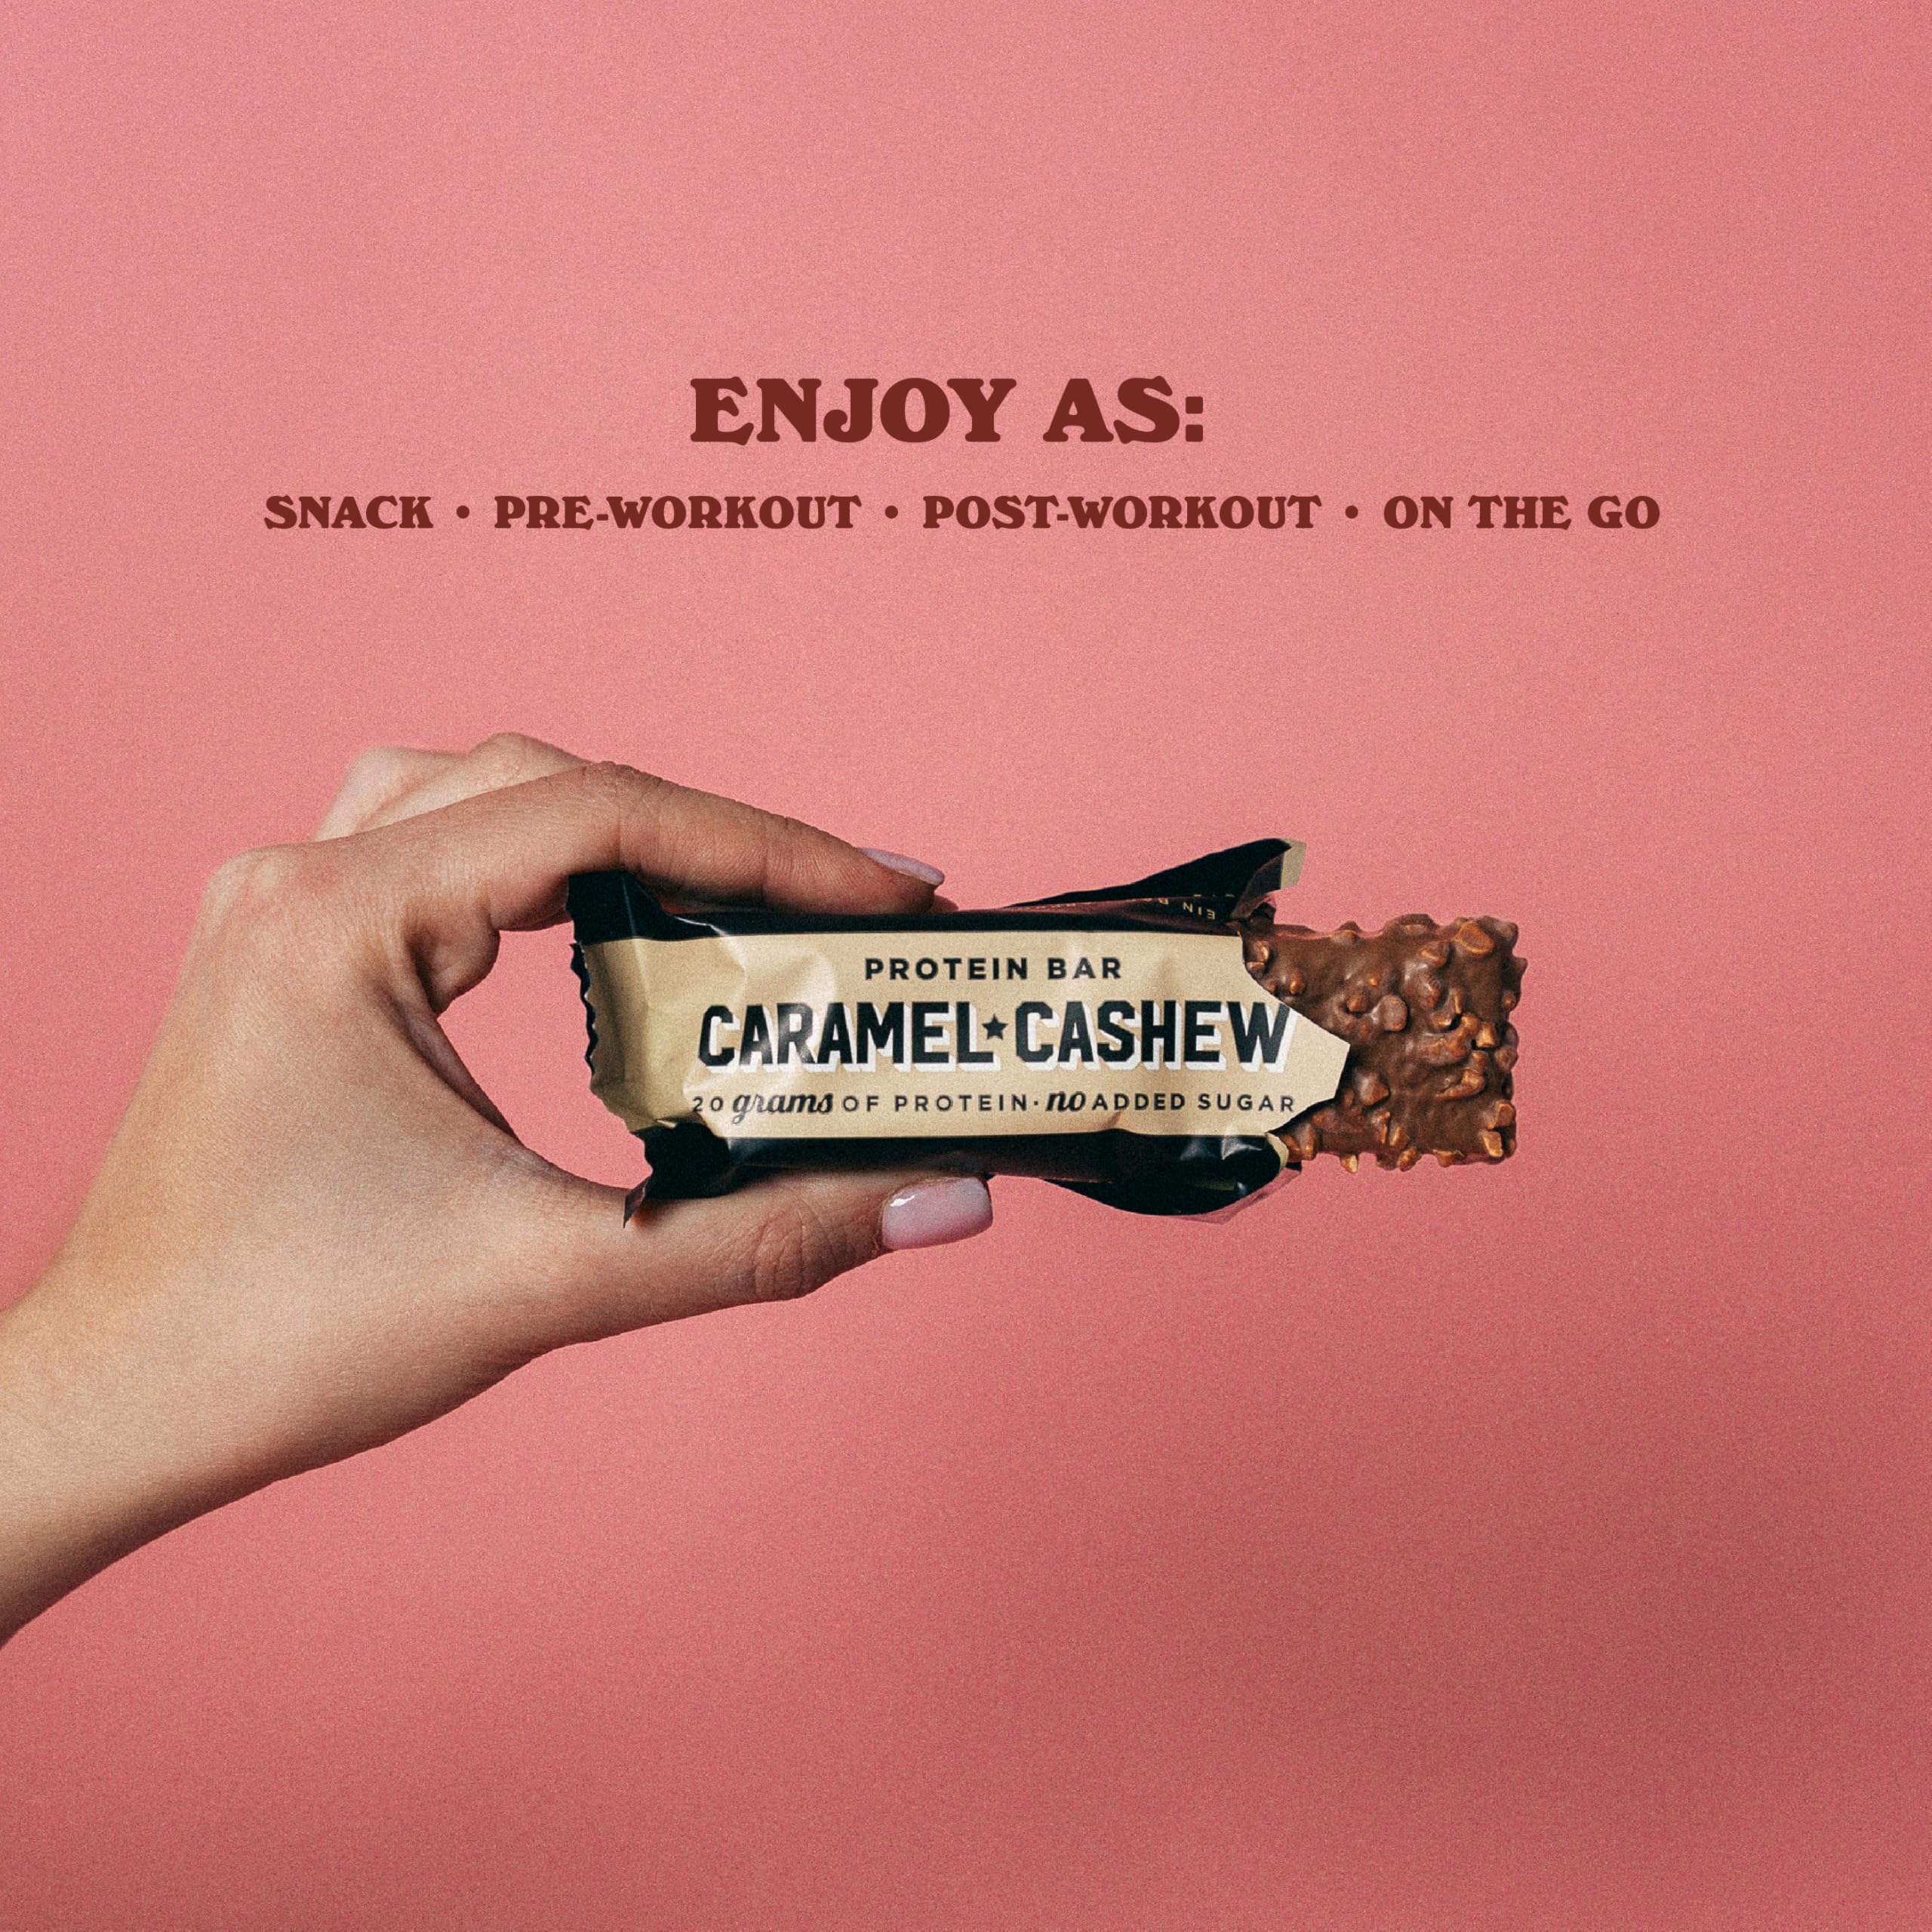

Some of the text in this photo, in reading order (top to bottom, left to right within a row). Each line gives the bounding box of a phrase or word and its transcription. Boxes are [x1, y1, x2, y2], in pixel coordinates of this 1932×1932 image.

[866, 957, 1121, 980] PROTEIN BAR
[697, 1000, 1298, 1073] CARAMEL CASHEW
[693, 1091, 1294, 1125] 20 grams OF PROTEIN no ADDED SUGAR
